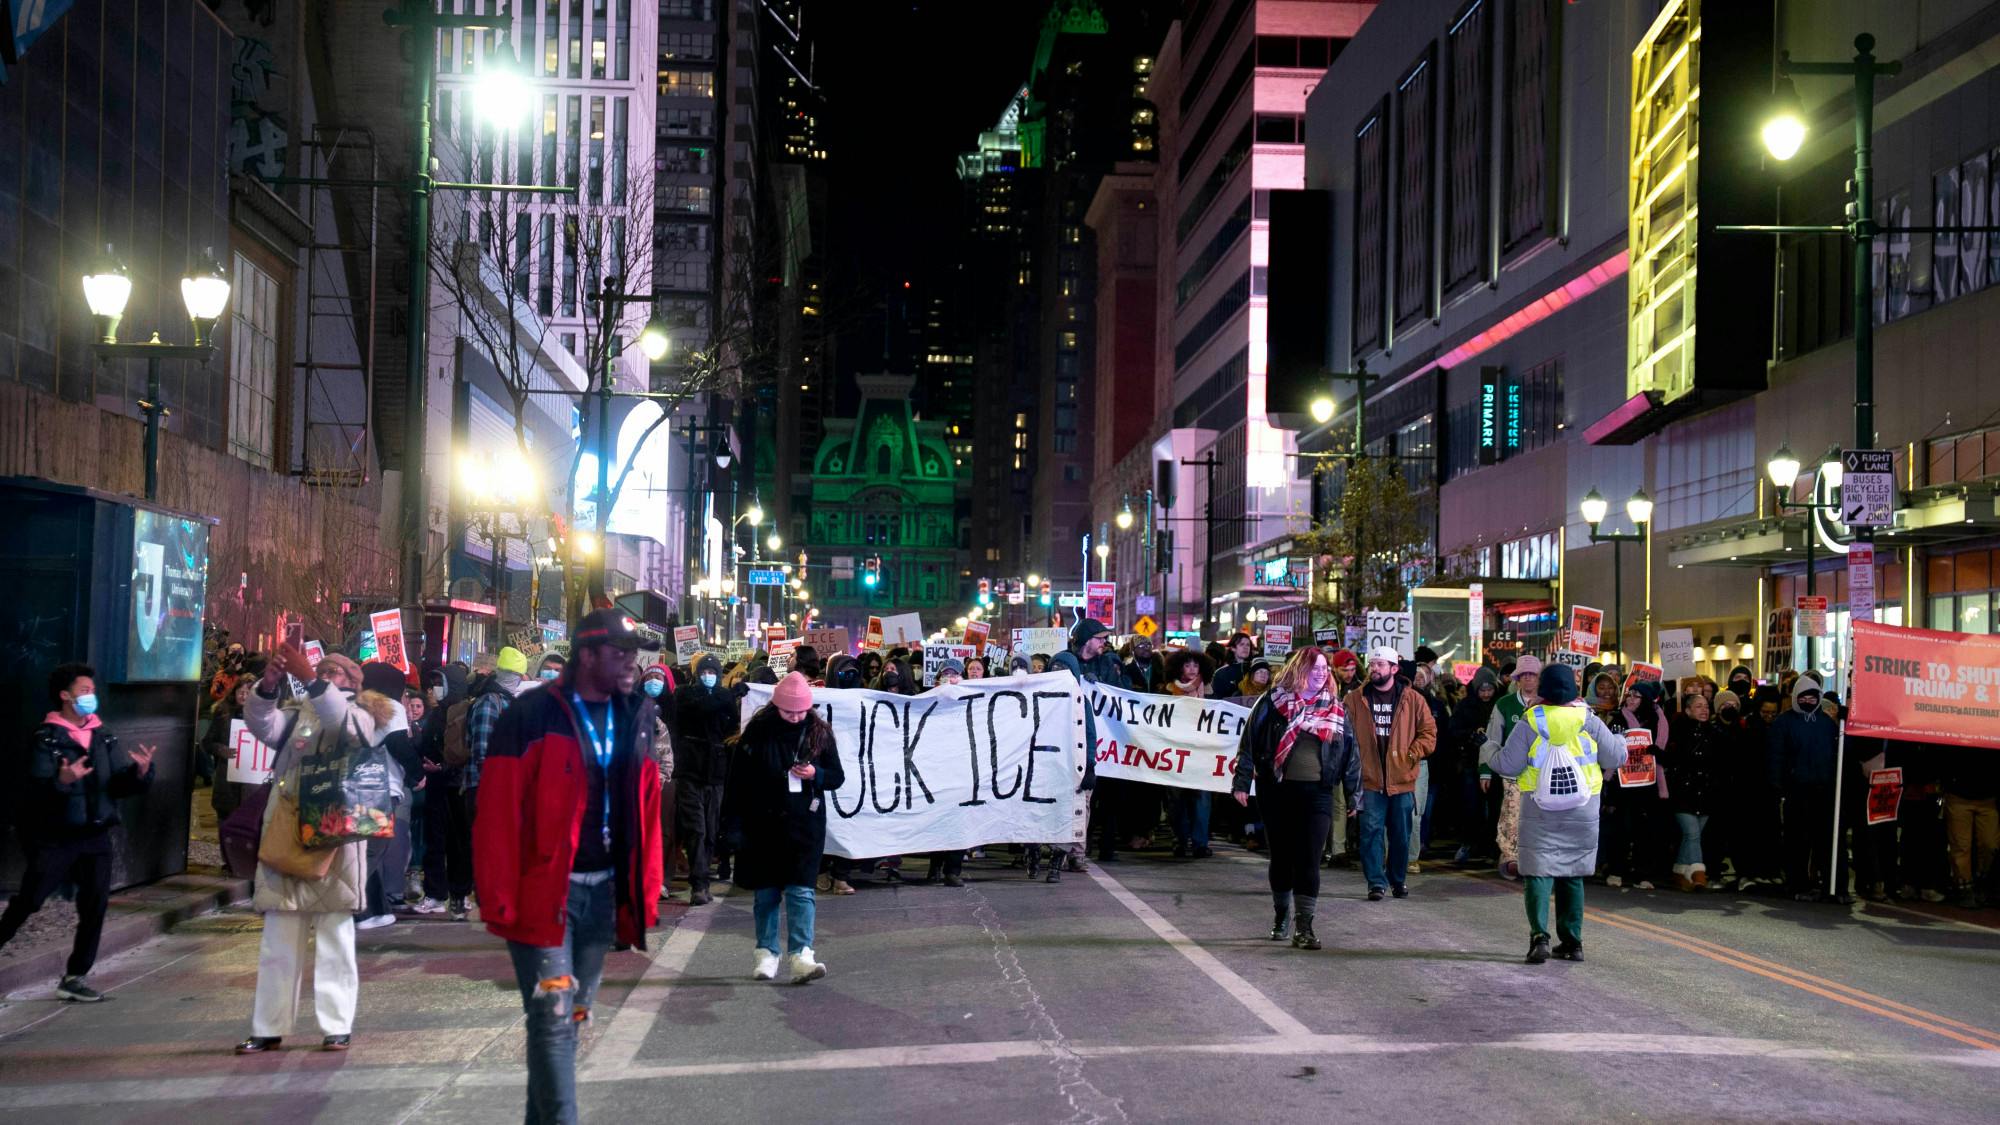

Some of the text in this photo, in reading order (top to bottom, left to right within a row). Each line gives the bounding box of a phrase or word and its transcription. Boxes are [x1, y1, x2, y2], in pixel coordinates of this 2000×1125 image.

[1482, 384, 1494, 447] PRIMARK
[1864, 463, 1889, 471] LANE
[1853, 475, 1882, 484] BUSES
[1845, 485, 1890, 493] BICYCLES
[1847, 494, 1888, 502] AND RIGHT
[1868, 513, 1889, 521] ONLY
[1368, 617, 1410, 634] ICE
[377, 635, 391, 648] ICE
[808, 632, 836, 644] ICE
[1493, 632, 1511, 640] ICE
[1371, 635, 1404, 651] OUT
[1489, 641, 1517, 649] COLD
[1661, 641, 1693, 650] ABOLISH
[926, 647, 949, 659] FUCK
[1551, 652, 1589, 665] RESIST
[1667, 652, 1689, 662] ICE
[926, 661, 940, 672] FU
[1865, 655, 1920, 678] STRIKE
[1927, 662, 1951, 681] TO
[1904, 677, 1989, 703] TRUMP &
[1091, 690, 1175, 728] UNION
[1373, 703, 1392, 711] NO ONE
[813, 689, 1070, 819] UCK ICE
